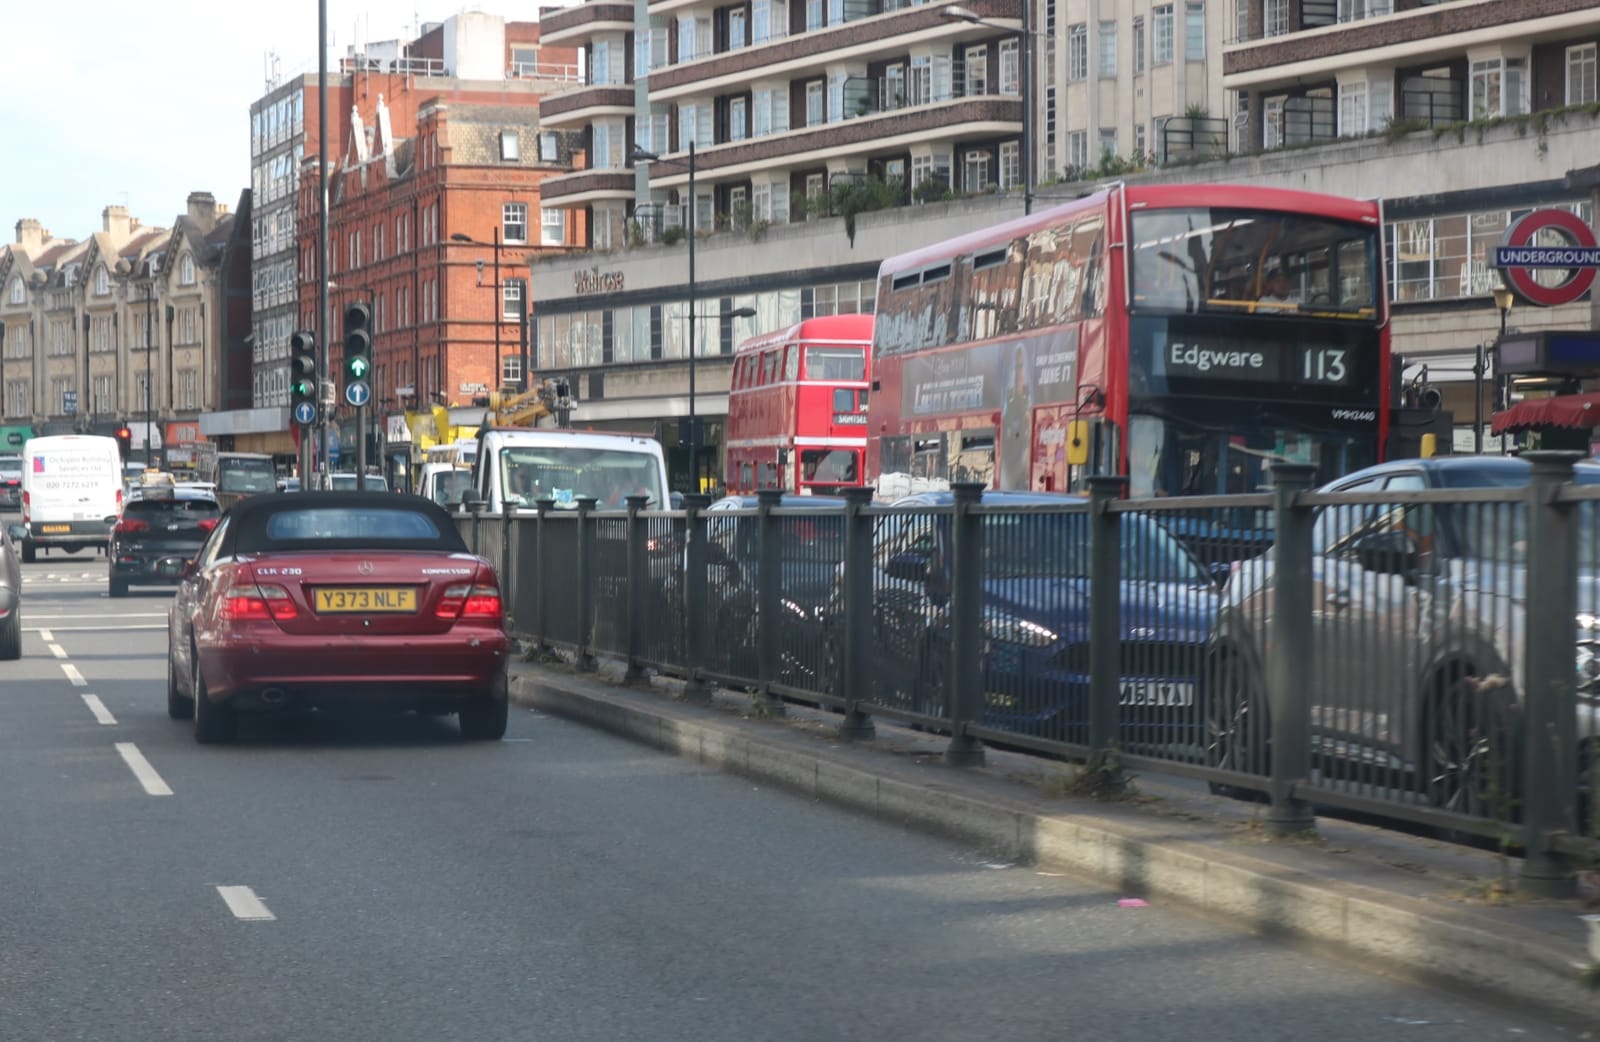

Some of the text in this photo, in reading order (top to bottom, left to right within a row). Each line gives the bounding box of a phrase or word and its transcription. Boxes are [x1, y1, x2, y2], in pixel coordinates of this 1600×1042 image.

[1500, 250, 1600, 263] UNDERGROUND
[1170, 343, 1264, 371] Edgware
[1303, 349, 1346, 381] 113
[323, 591, 408, 608] Y373 NLF
